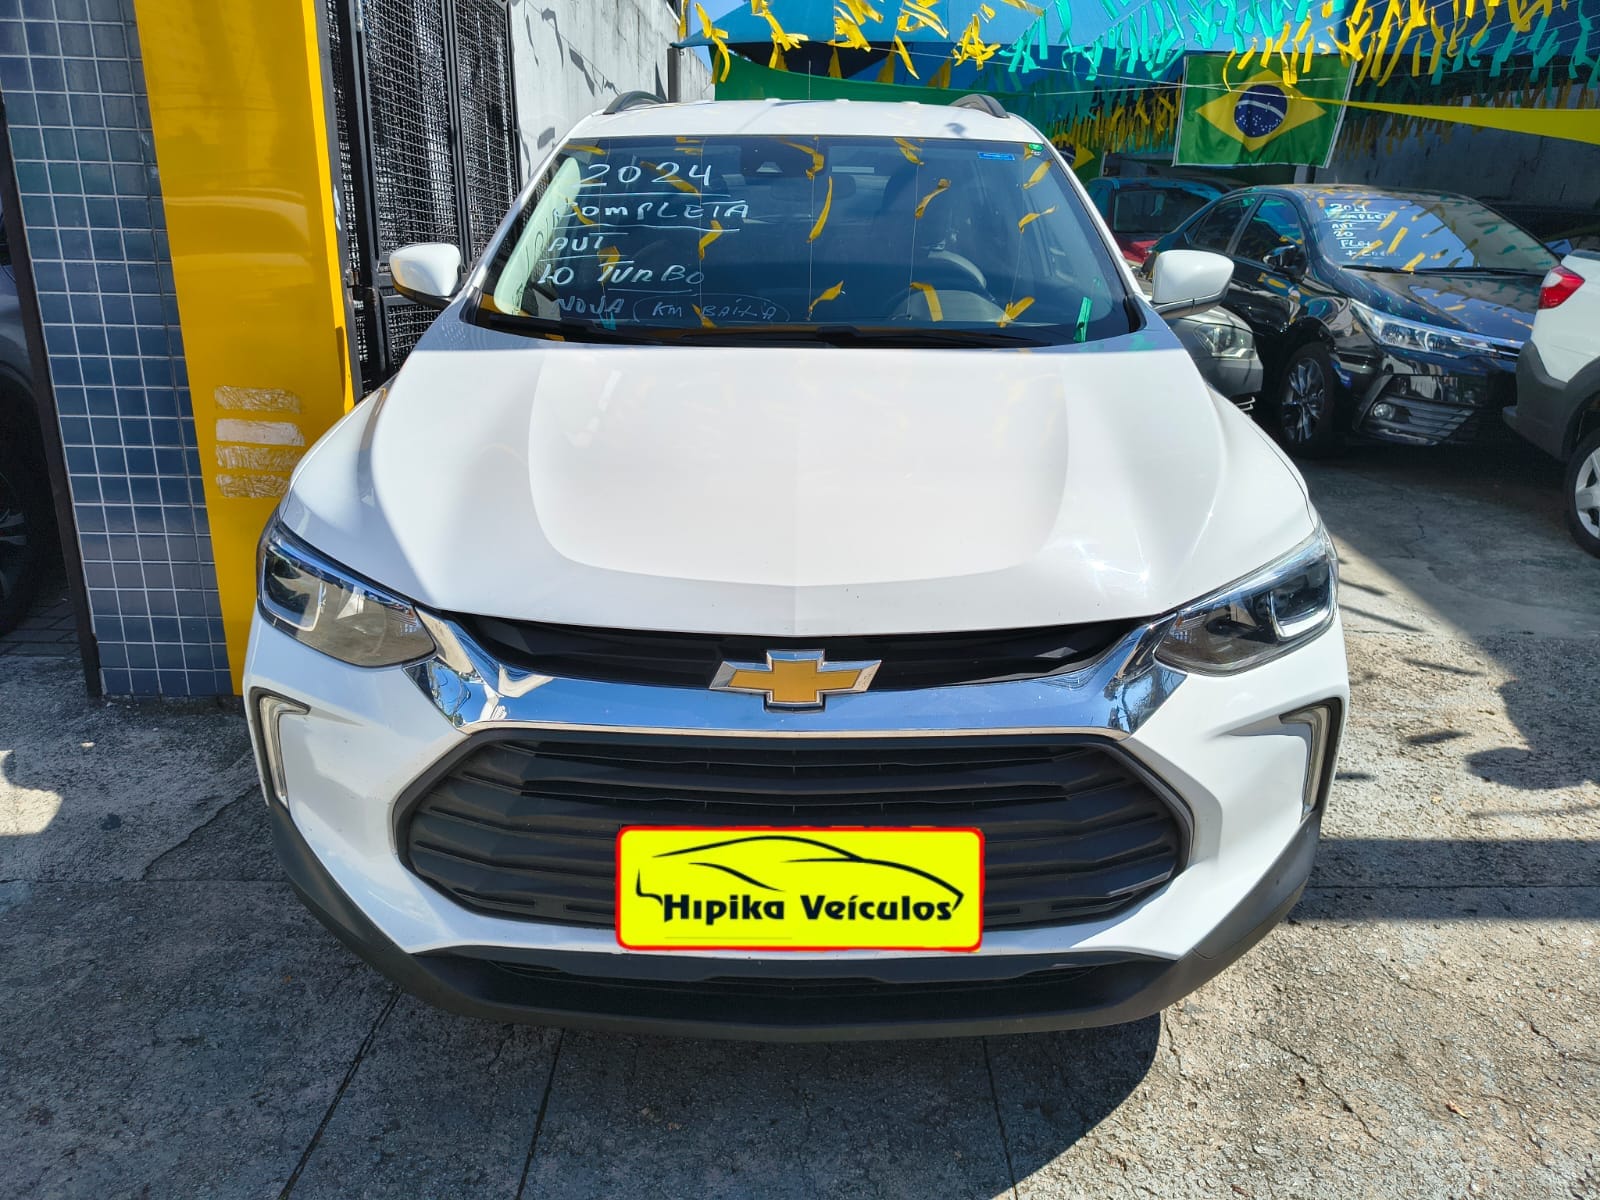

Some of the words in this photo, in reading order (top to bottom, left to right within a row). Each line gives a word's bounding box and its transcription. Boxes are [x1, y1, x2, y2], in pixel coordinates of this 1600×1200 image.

[577, 161, 712, 187] 2024
[554, 200, 749, 221] COMPLETA
[548, 232, 629, 252] AUT
[597, 260, 704, 285] TURBO
[555, 295, 624, 315] NOVA
[652, 302, 682, 318] KM
[702, 298, 777, 320] BAIXA
